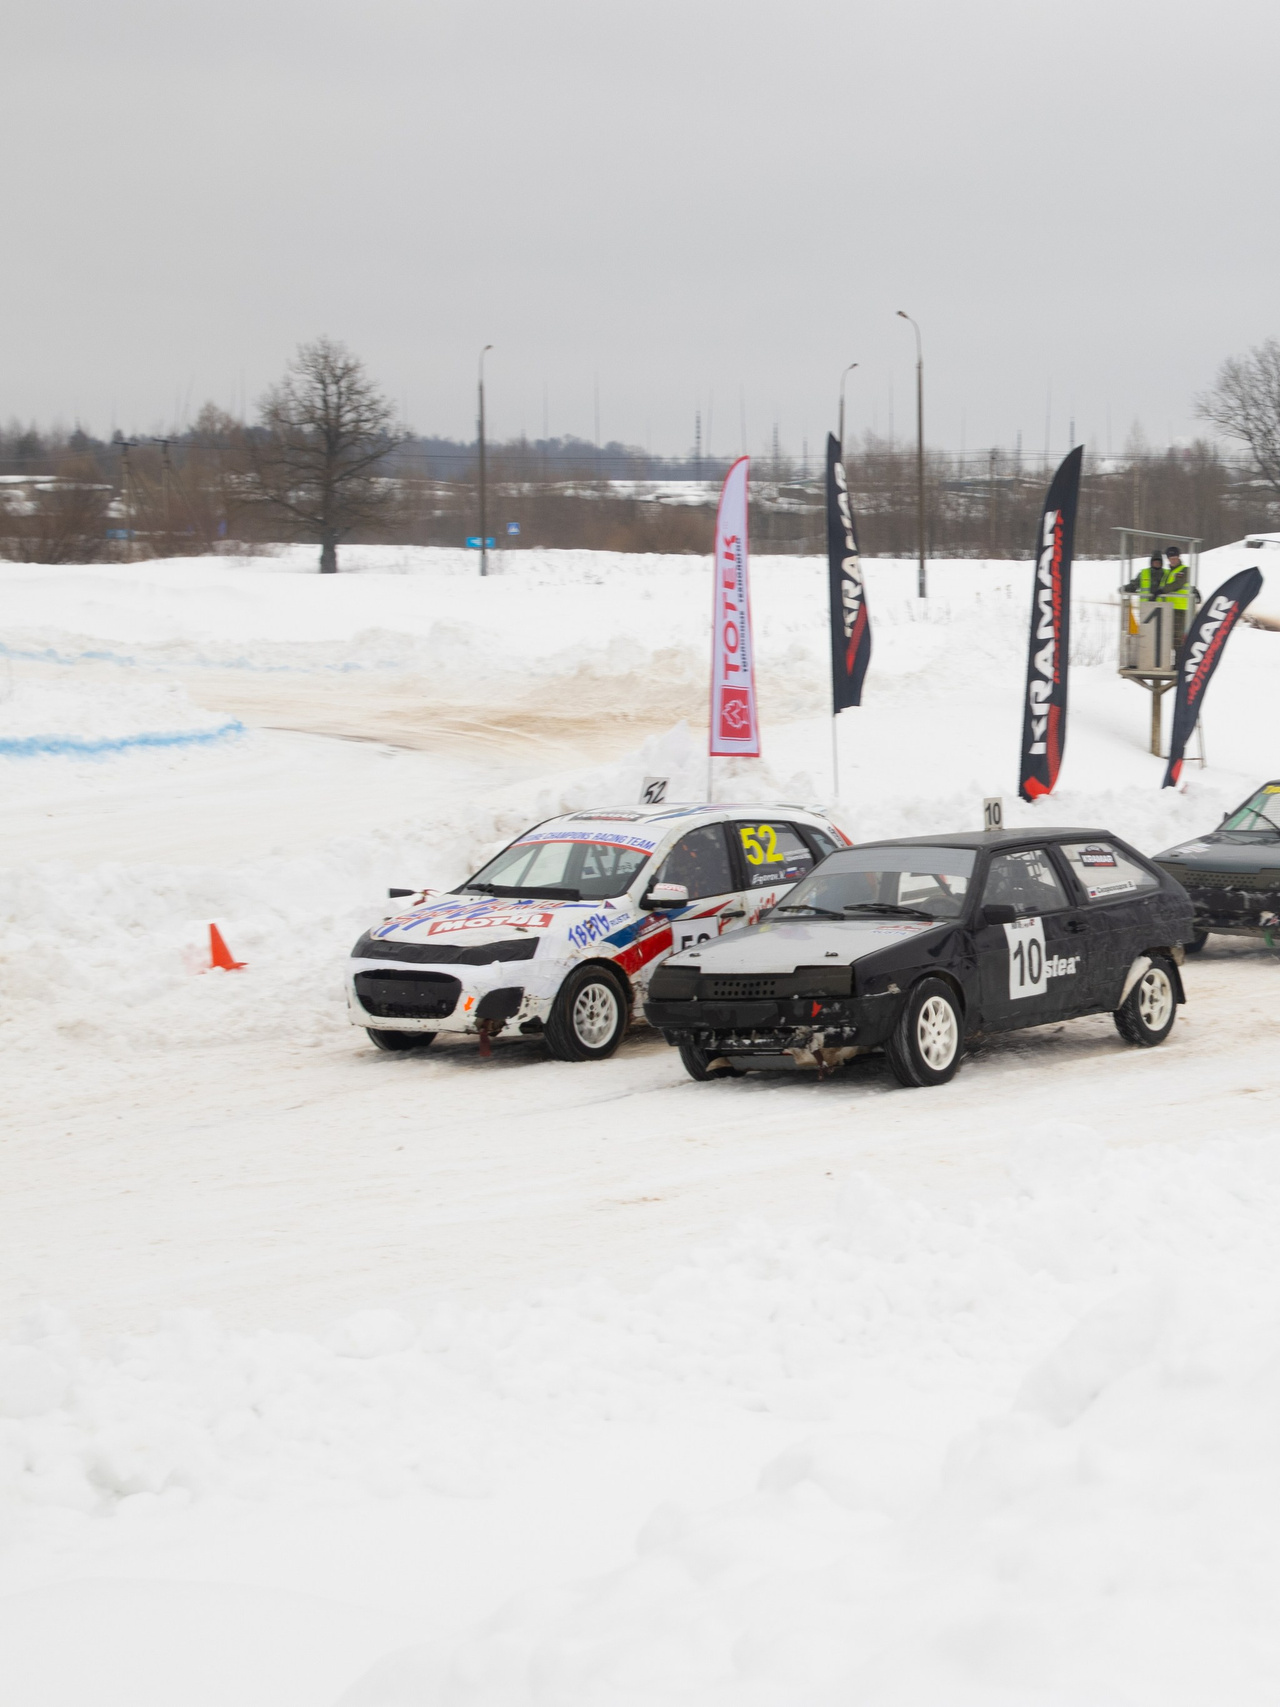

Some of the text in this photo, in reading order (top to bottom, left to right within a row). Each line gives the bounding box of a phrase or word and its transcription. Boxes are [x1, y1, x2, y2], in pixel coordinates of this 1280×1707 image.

[1142, 606, 1162, 668] 1
[644, 781, 667, 804] 52
[984, 802, 1001, 826] 10
[593, 832, 628, 844] RACING
[628, 836, 657, 850] TEAM
[740, 825, 784, 865] 52
[436, 913, 543, 933] MOTUL
[568, 913, 610, 950] ТВЕРЬ
[1013, 937, 1043, 987] 10
